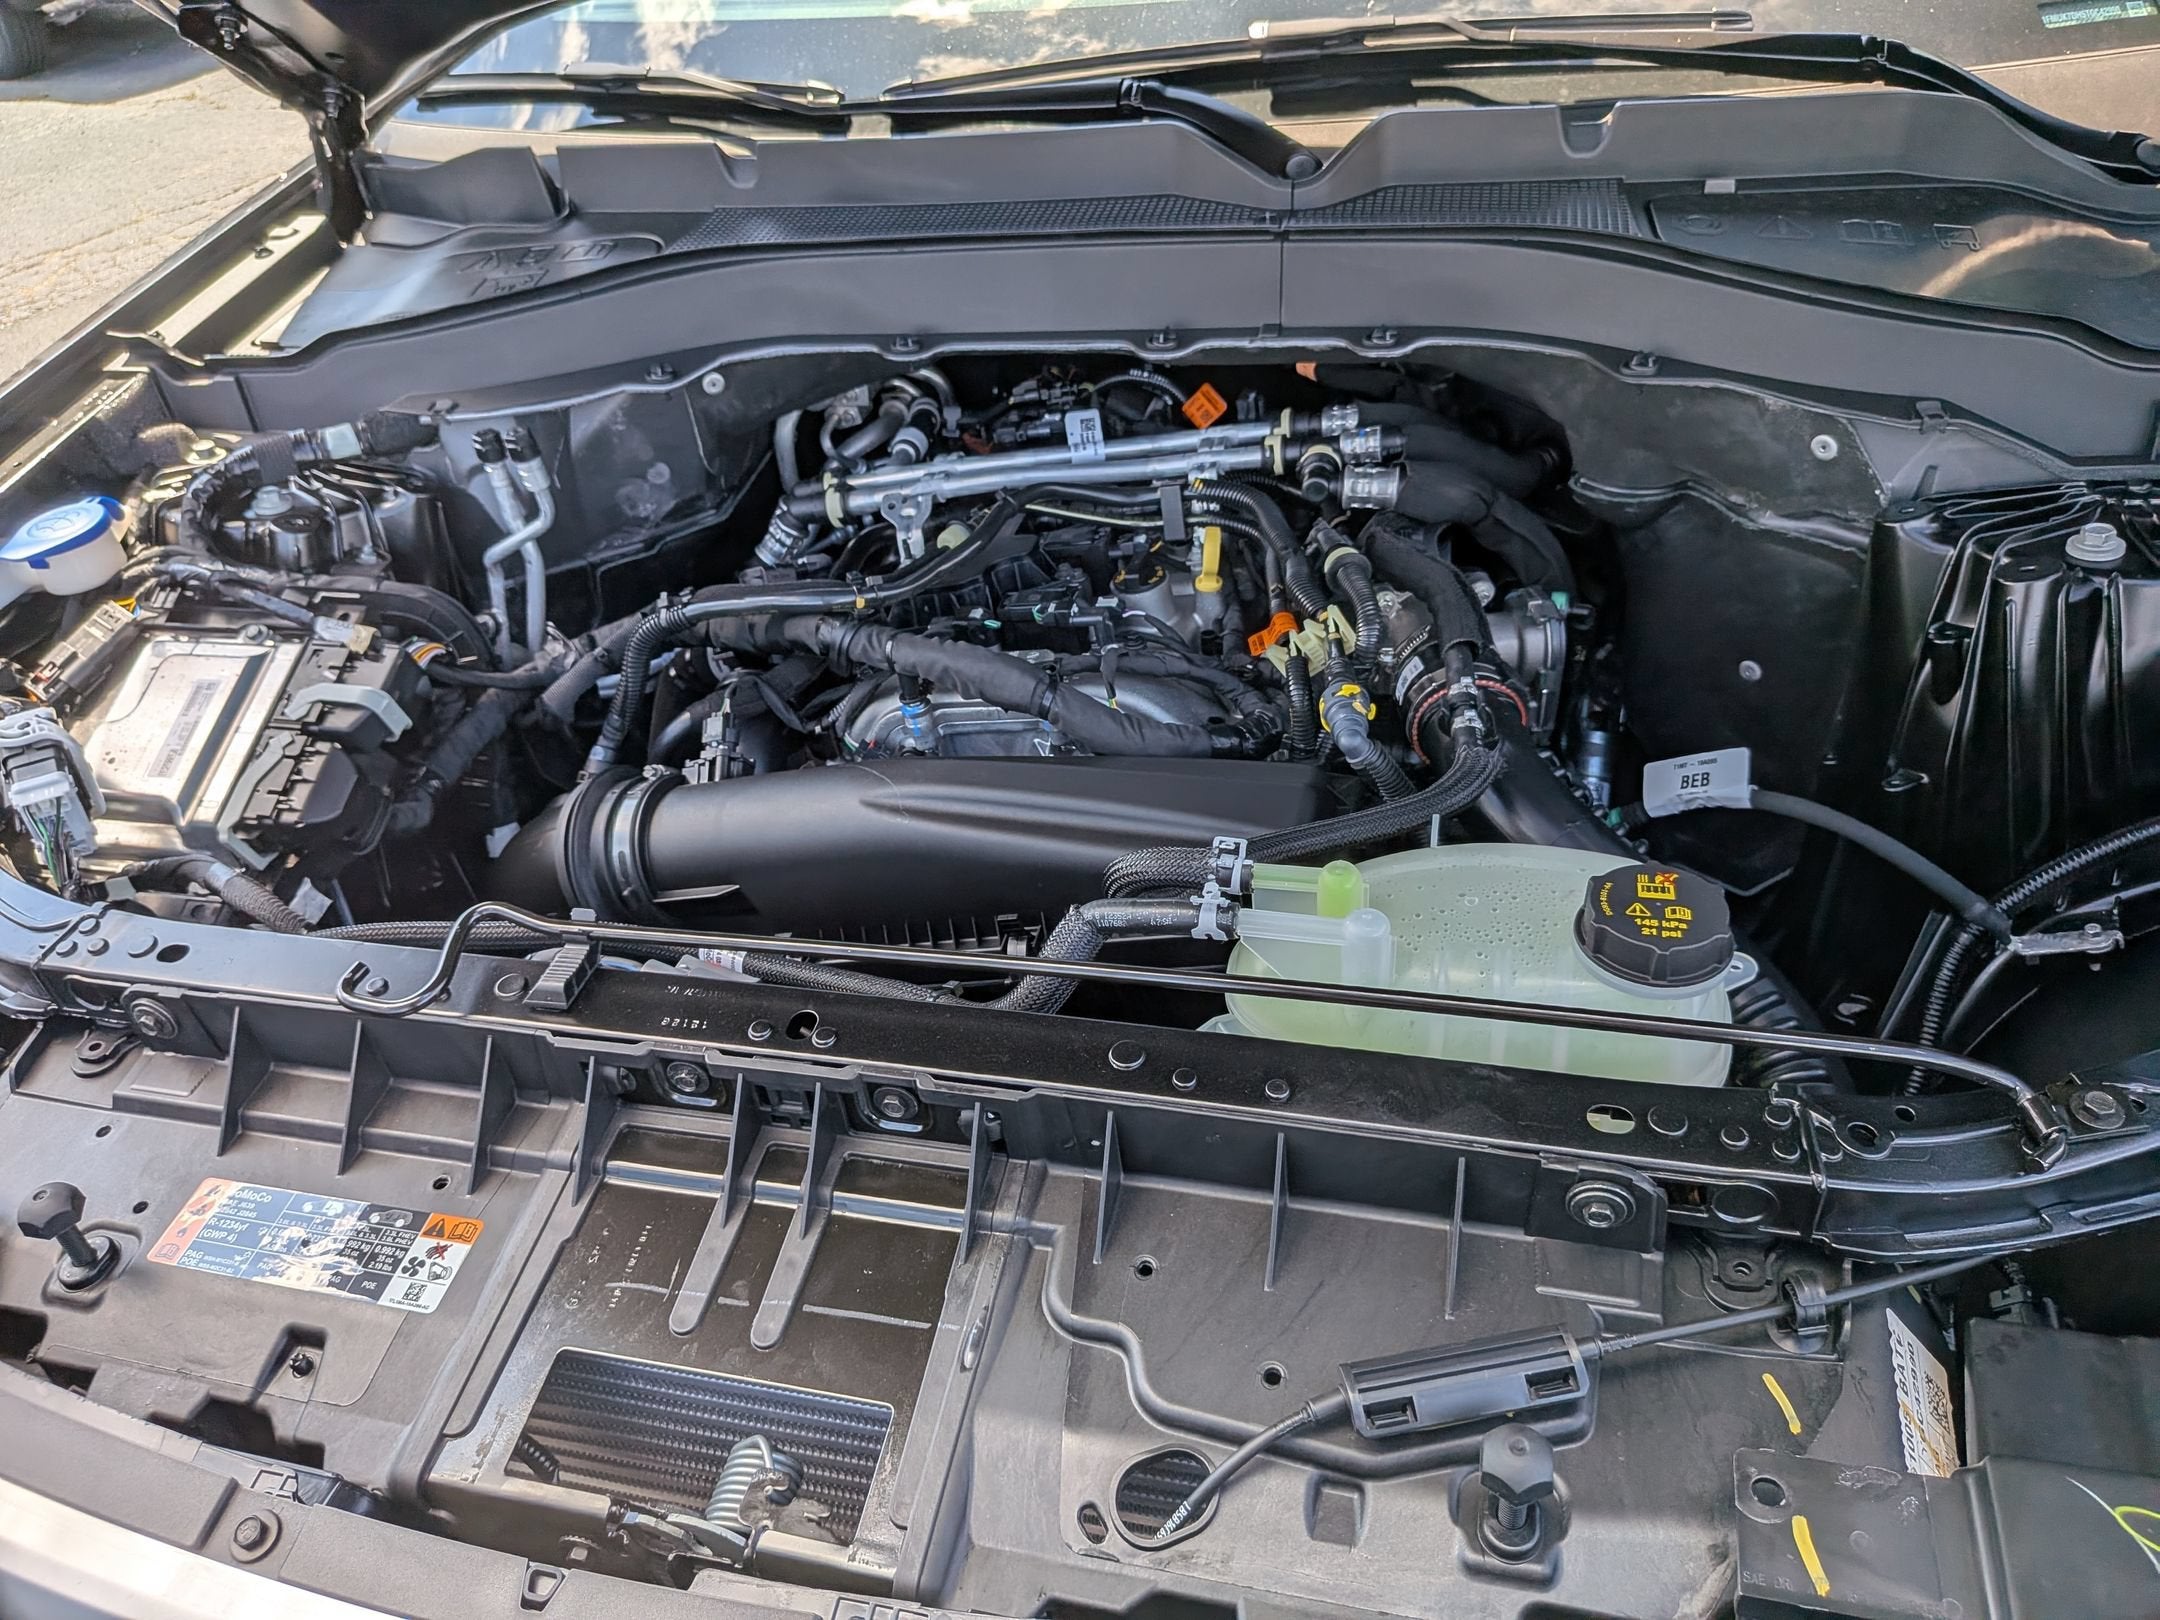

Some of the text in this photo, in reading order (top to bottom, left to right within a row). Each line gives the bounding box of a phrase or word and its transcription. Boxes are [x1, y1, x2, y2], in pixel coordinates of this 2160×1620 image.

[1679, 772, 1710, 789] BEB
[1634, 918, 1688, 930] 145 kPa
[1641, 927, 1682, 938] 21 psi
[234, 1189, 273, 1203] oMoCo
[208, 1217, 251, 1233] R-1234yf
[199, 1228, 239, 1244] (GWP 4)
[360, 1241, 372, 1253] kg
[374, 1244, 406, 1259] 0.992 kg
[184, 1249, 204, 1259] PAG
[180, 1256, 200, 1267] POE
[360, 1280, 378, 1290] POE
